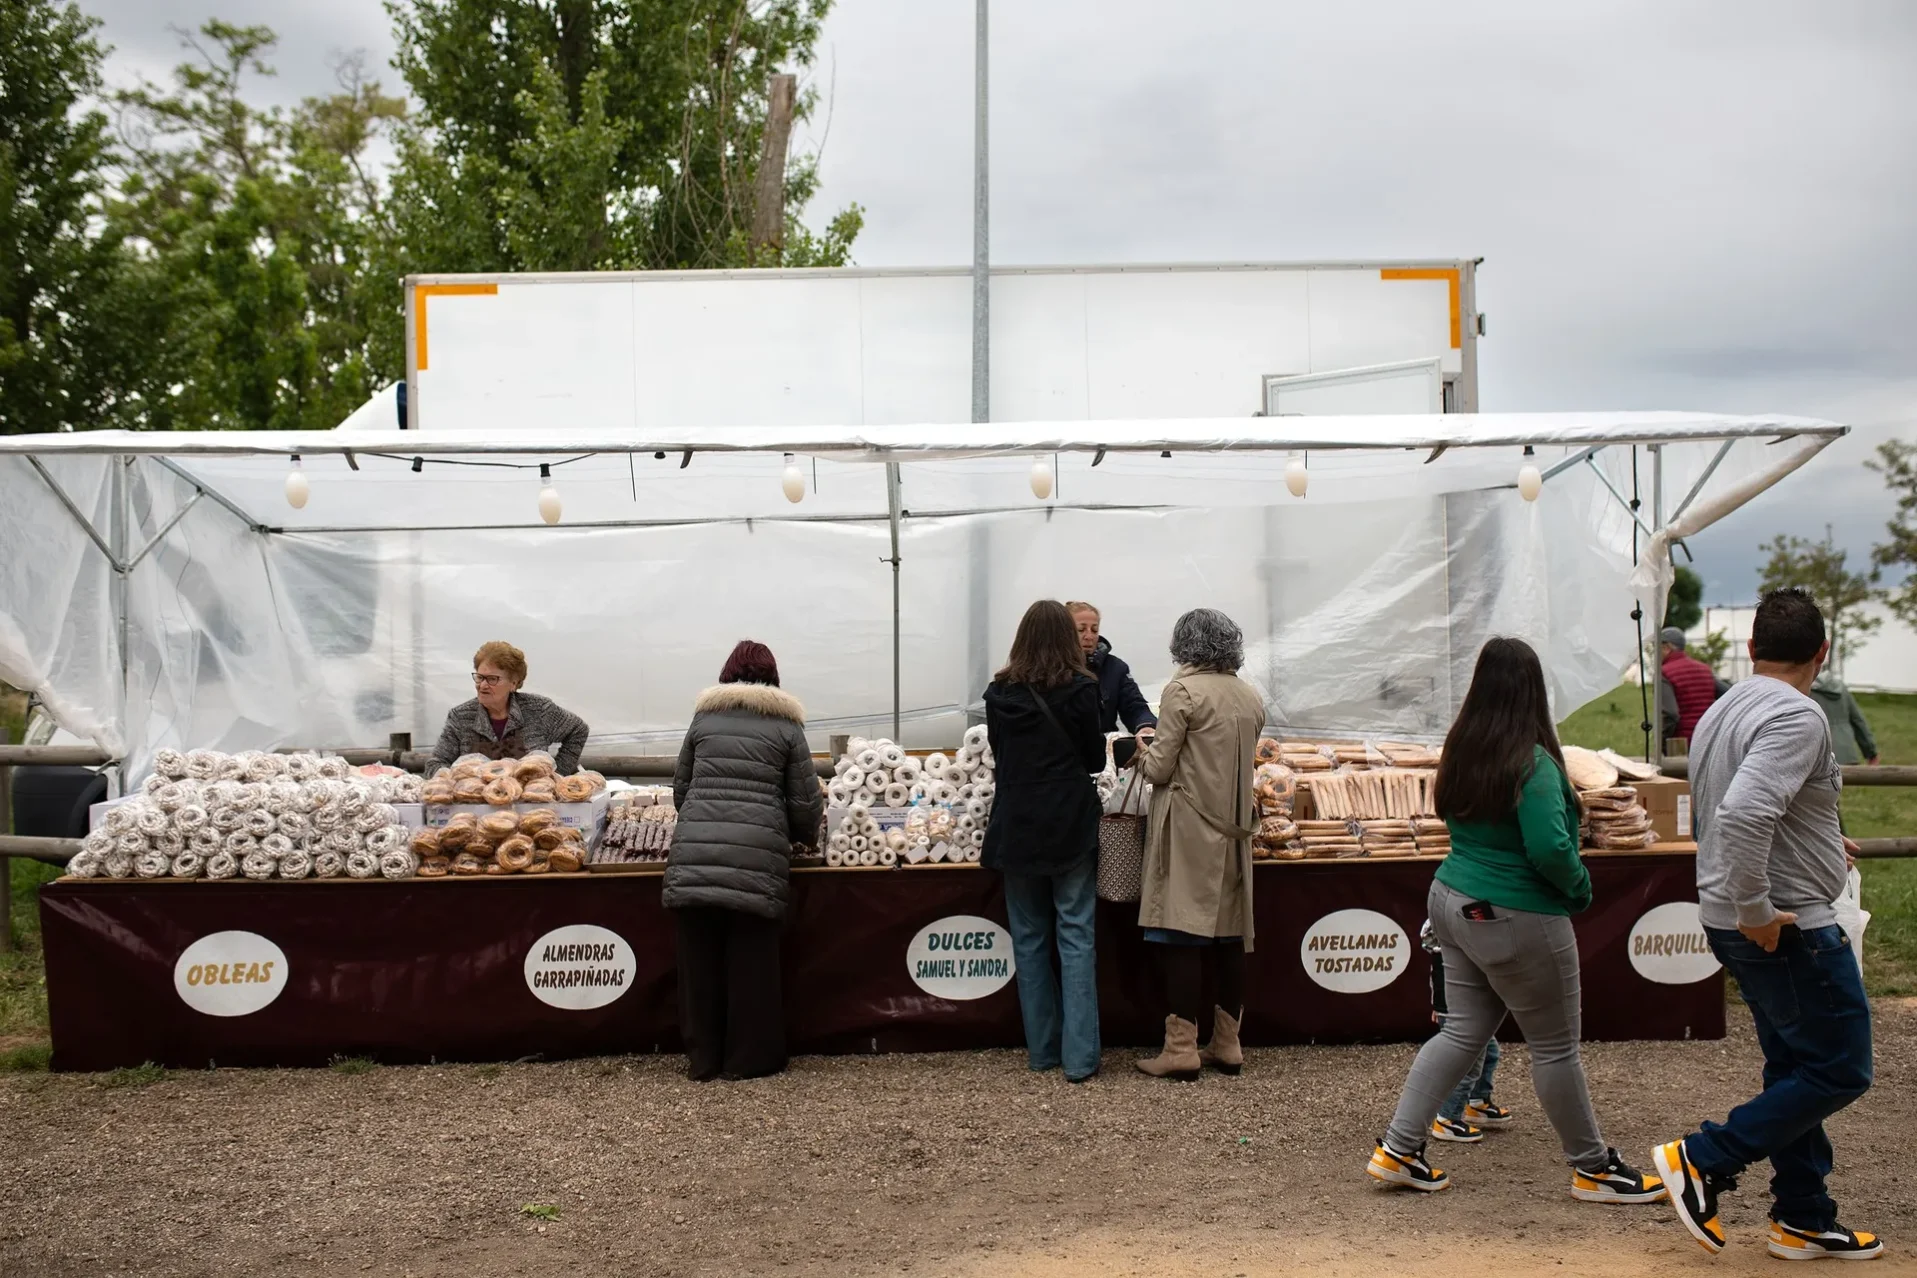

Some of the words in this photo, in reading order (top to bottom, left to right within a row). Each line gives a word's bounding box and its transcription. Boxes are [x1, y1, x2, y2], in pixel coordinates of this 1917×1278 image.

[928, 931, 995, 951] DULCES
[1308, 933, 1399, 951] AVELLANAS
[542, 943, 615, 962] ALMENDRAS
[187, 961, 274, 986] OBLEAS
[916, 959, 956, 978] SAMUEL
[959, 959, 965, 977] Y
[967, 958, 1008, 978] SANDRA
[1315, 956, 1394, 973] TOSTADAS
[533, 965, 625, 989] GARRAPIÑADAS
